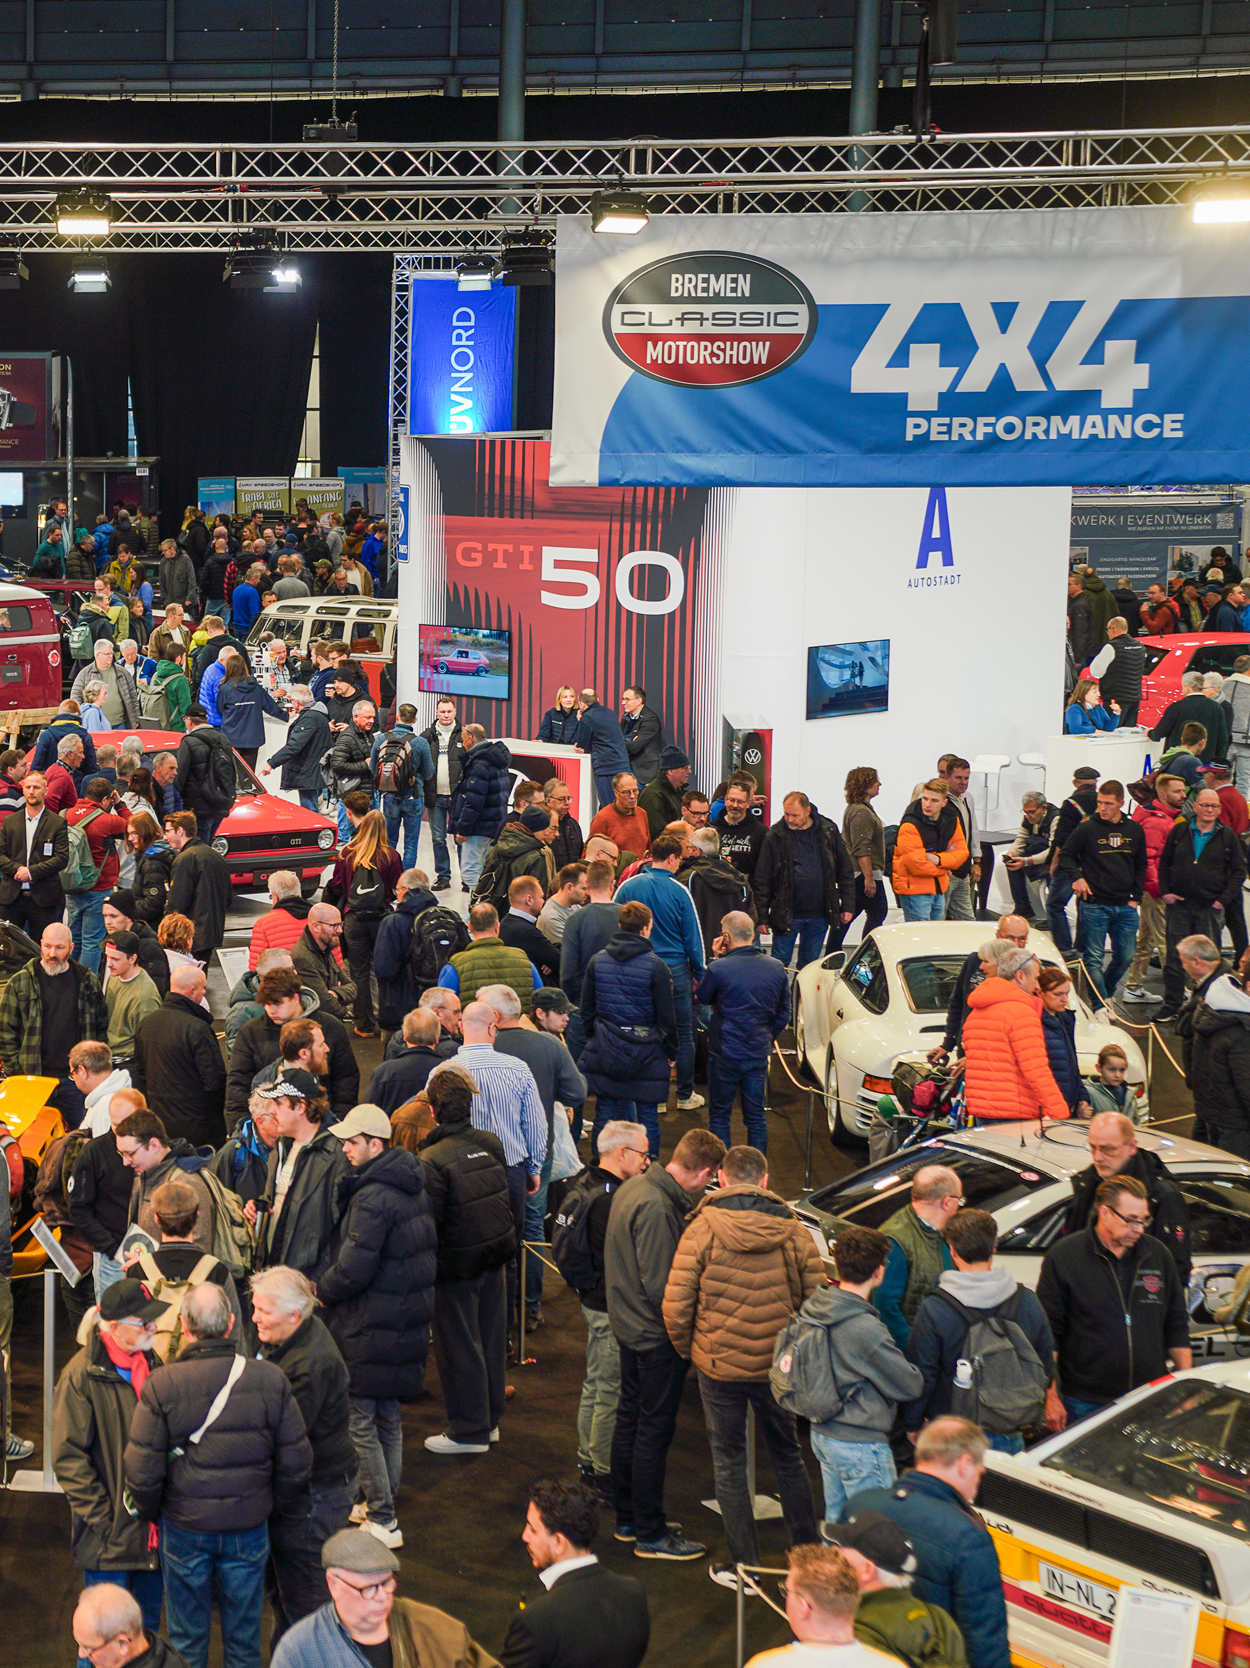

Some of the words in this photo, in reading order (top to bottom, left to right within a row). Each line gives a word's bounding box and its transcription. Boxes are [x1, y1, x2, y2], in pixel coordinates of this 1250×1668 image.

[670, 273, 751, 298] BREMEN
[620, 310, 800, 328] CLASSIC
[646, 340, 771, 365] MOTORSHOW
[850, 298, 1151, 412] 4X4
[905, 413, 1185, 442] PERFORMANCE
[240, 491, 266, 504] TRABI
[252, 499, 283, 511] AFRICA
[306, 491, 342, 505] ANFANG
[1127, 513, 1213, 526] EVENTWERK
[455, 541, 534, 571] GTI
[540, 545, 685, 616] 50
[907, 574, 962, 589] AUTOSTADT
[290, 838, 302, 846] GTI
[1046, 1566, 1103, 1611] IN-NL
